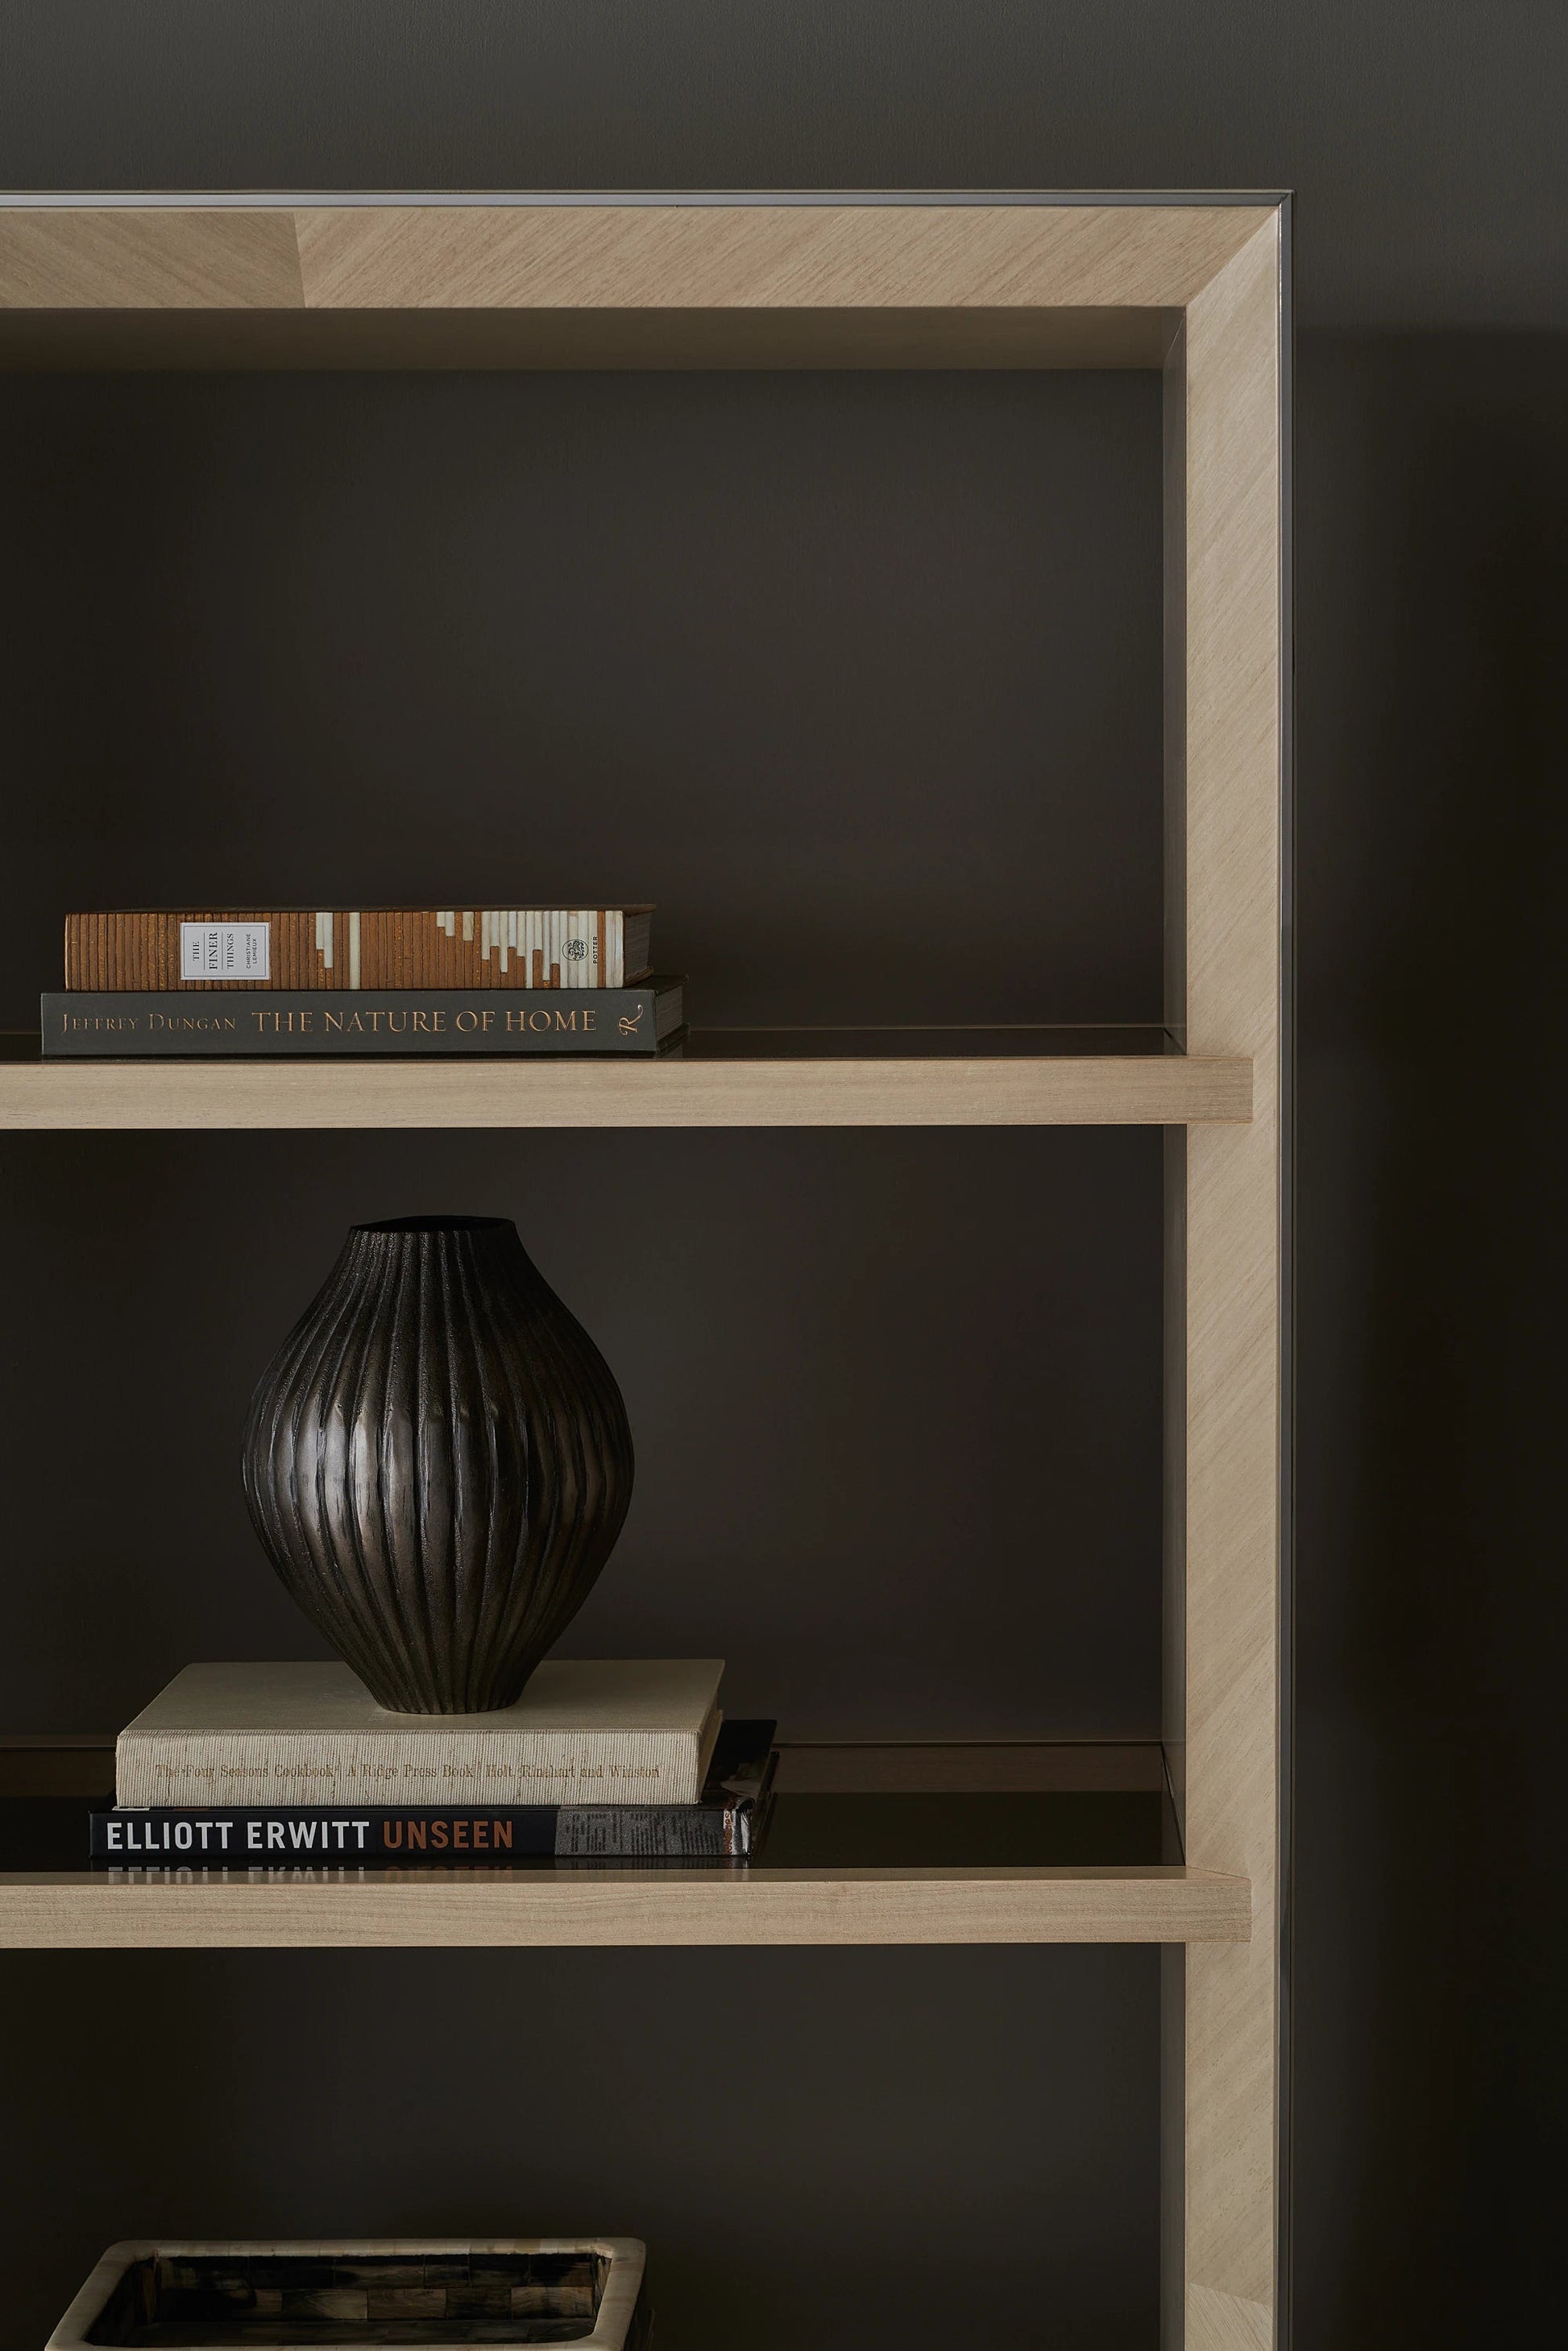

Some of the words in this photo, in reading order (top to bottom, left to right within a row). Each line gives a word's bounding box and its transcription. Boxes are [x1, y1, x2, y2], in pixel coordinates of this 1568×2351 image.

[209, 932, 218, 969] FINER
[62, 1013, 139, 1033] JEFFREY
[149, 1013, 237, 1031] DUNGAN
[251, 1011, 313, 1032] THE
[324, 1010, 446, 1032] NATURE
[456, 1010, 496, 1032] OF
[507, 1010, 597, 1032] HOME
[156, 1764, 180, 1778] The
[220, 1764, 268, 1778] Seasons
[274, 1764, 334, 1779] Cookbook
[346, 1764, 357, 1778] A
[361, 1764, 399, 1780] Ridge
[404, 1764, 437, 1778] Press
[442, 1764, 474, 1778] Book
[580, 1764, 604, 1778] and
[608, 1764, 660, 1778] Winston
[106, 1821, 234, 1850] ELLIOTT
[247, 1820, 370, 1850] ERWITT
[383, 1820, 513, 1849] UNSEEN
